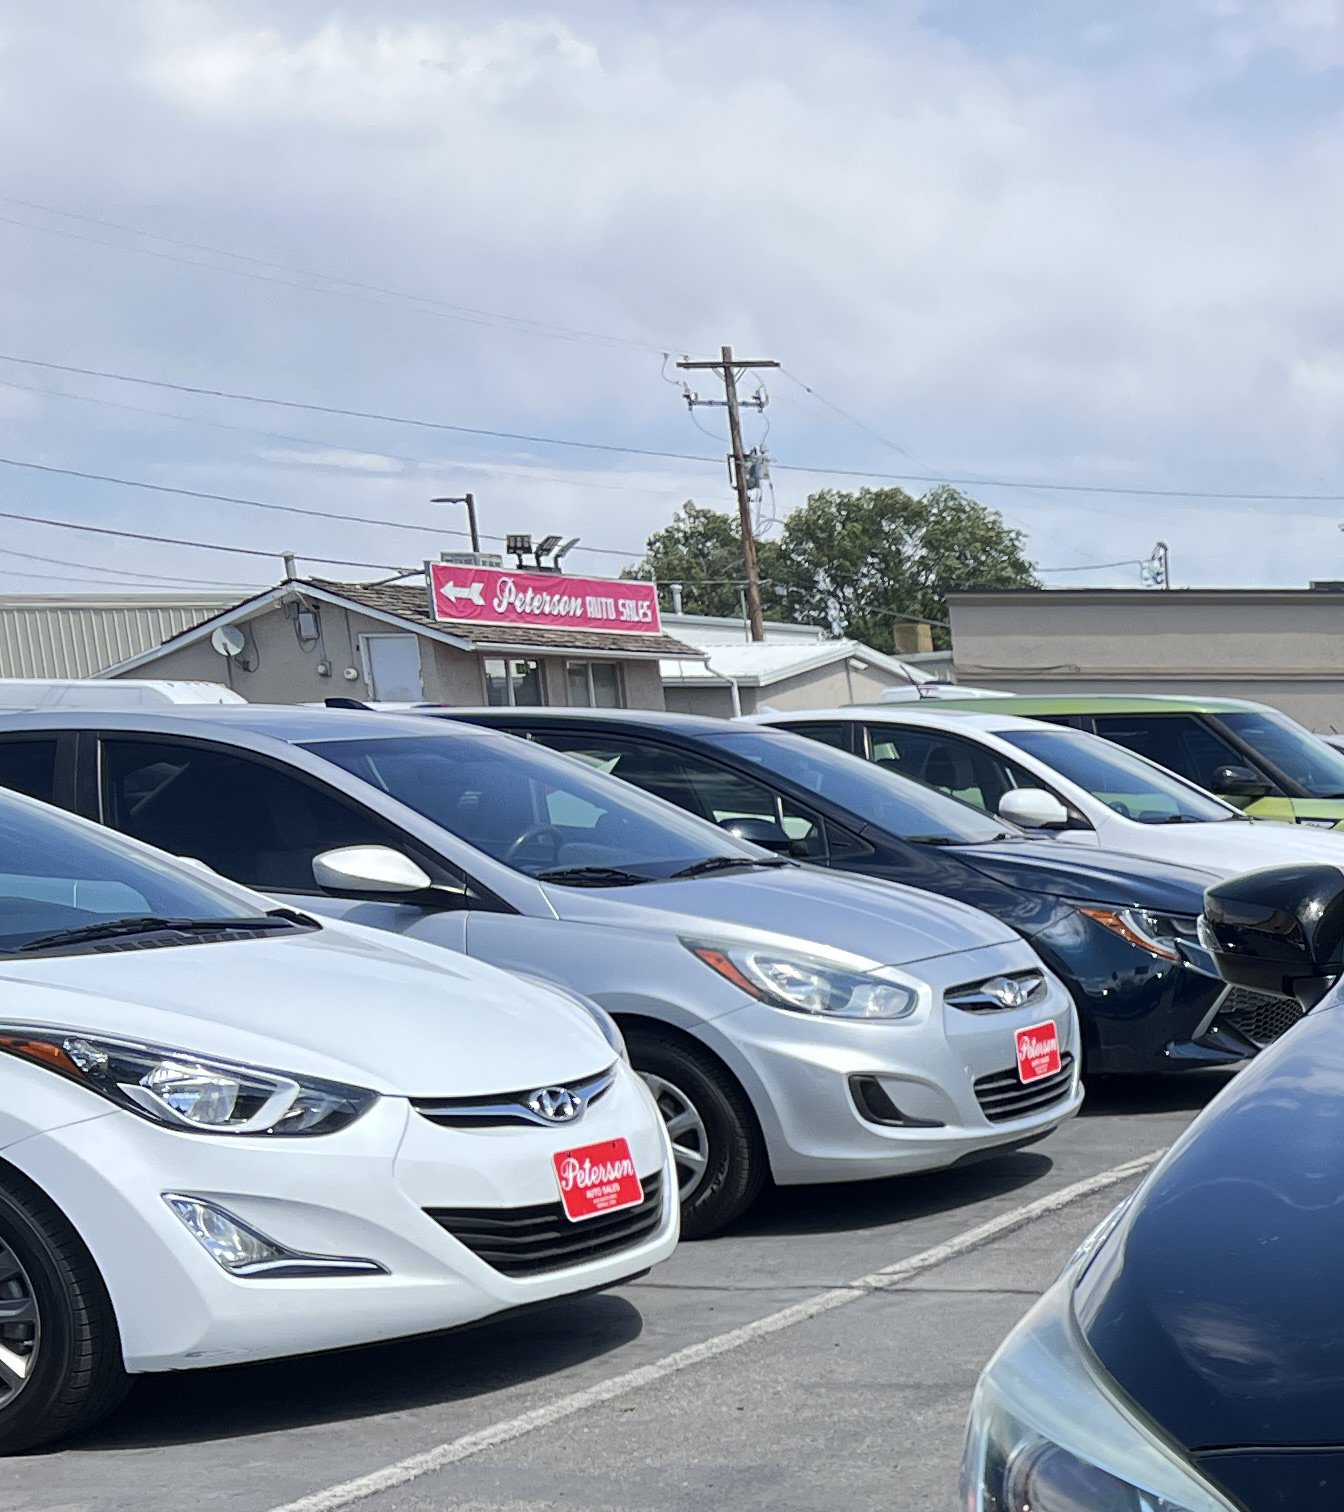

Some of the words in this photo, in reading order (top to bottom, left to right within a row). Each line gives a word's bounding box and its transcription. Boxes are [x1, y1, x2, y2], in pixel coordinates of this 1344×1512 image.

[493, 576, 584, 617] Peterson
[586, 596, 616, 620] AUTO
[618, 598, 653, 623] SALES
[560, 1157, 634, 1192] Peterson
